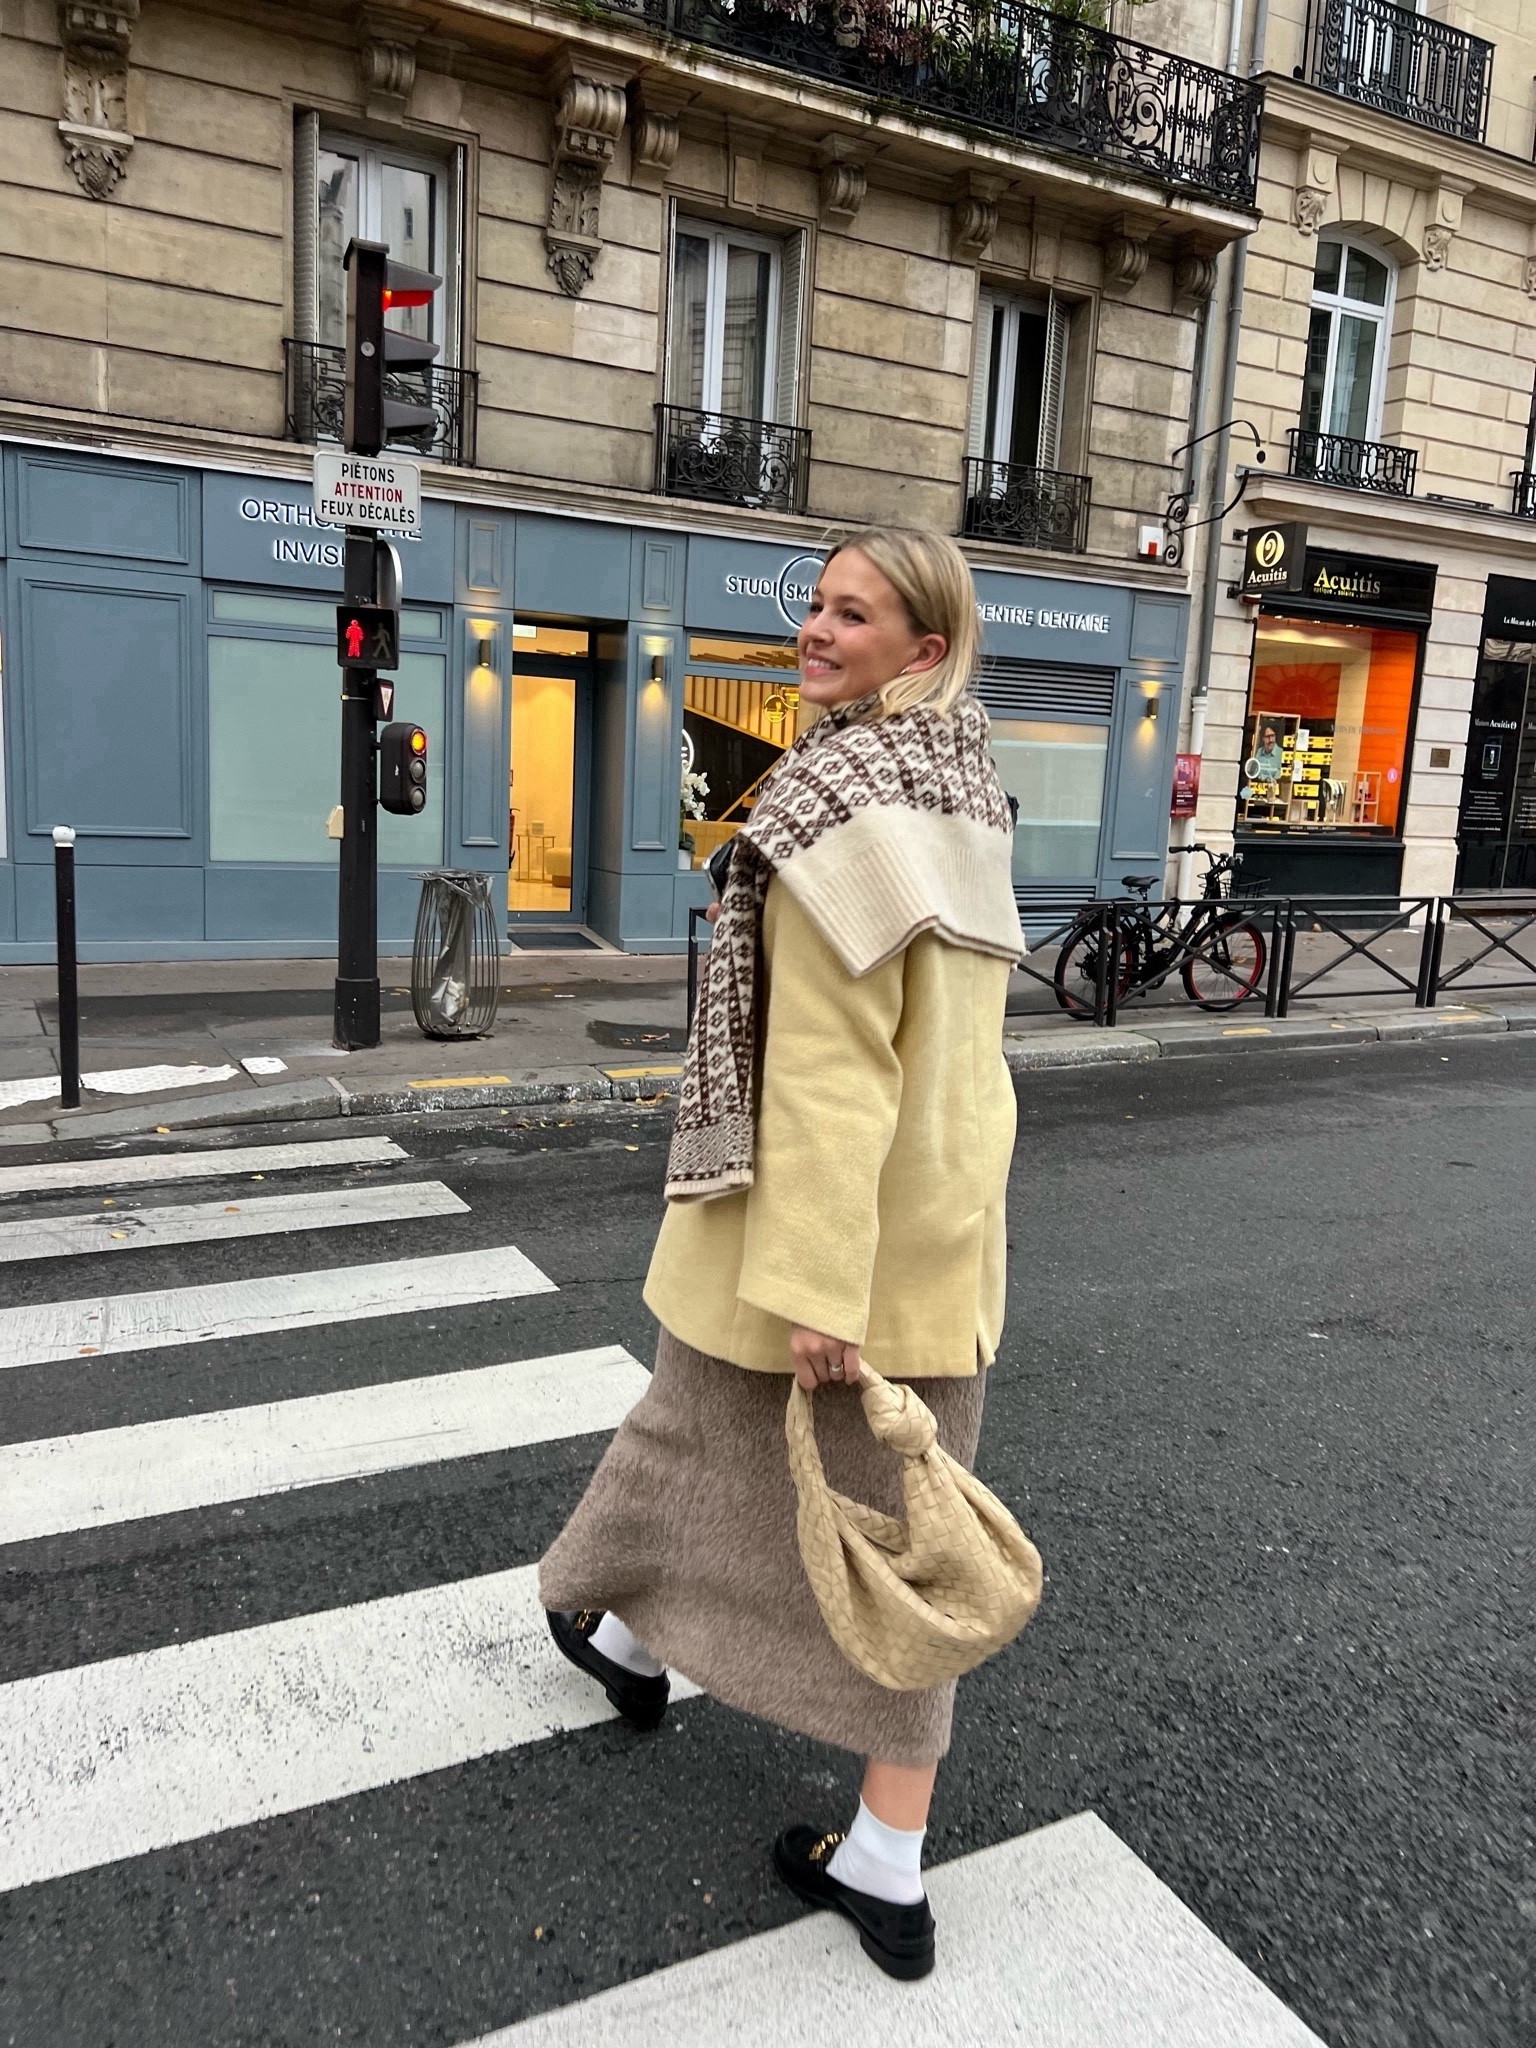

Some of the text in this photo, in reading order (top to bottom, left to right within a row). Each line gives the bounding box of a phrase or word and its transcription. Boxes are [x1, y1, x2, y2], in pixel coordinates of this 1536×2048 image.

[341, 462, 395, 483] PIÉTONS
[334, 481, 403, 503] ATTENTION
[321, 499, 354, 517] FEUX
[359, 502, 415, 524] DÉCALÉS
[1247, 567, 1288, 584] Acuitis
[1313, 566, 1381, 594] Acuitis
[1039, 609, 1111, 633] DENTAIRE
